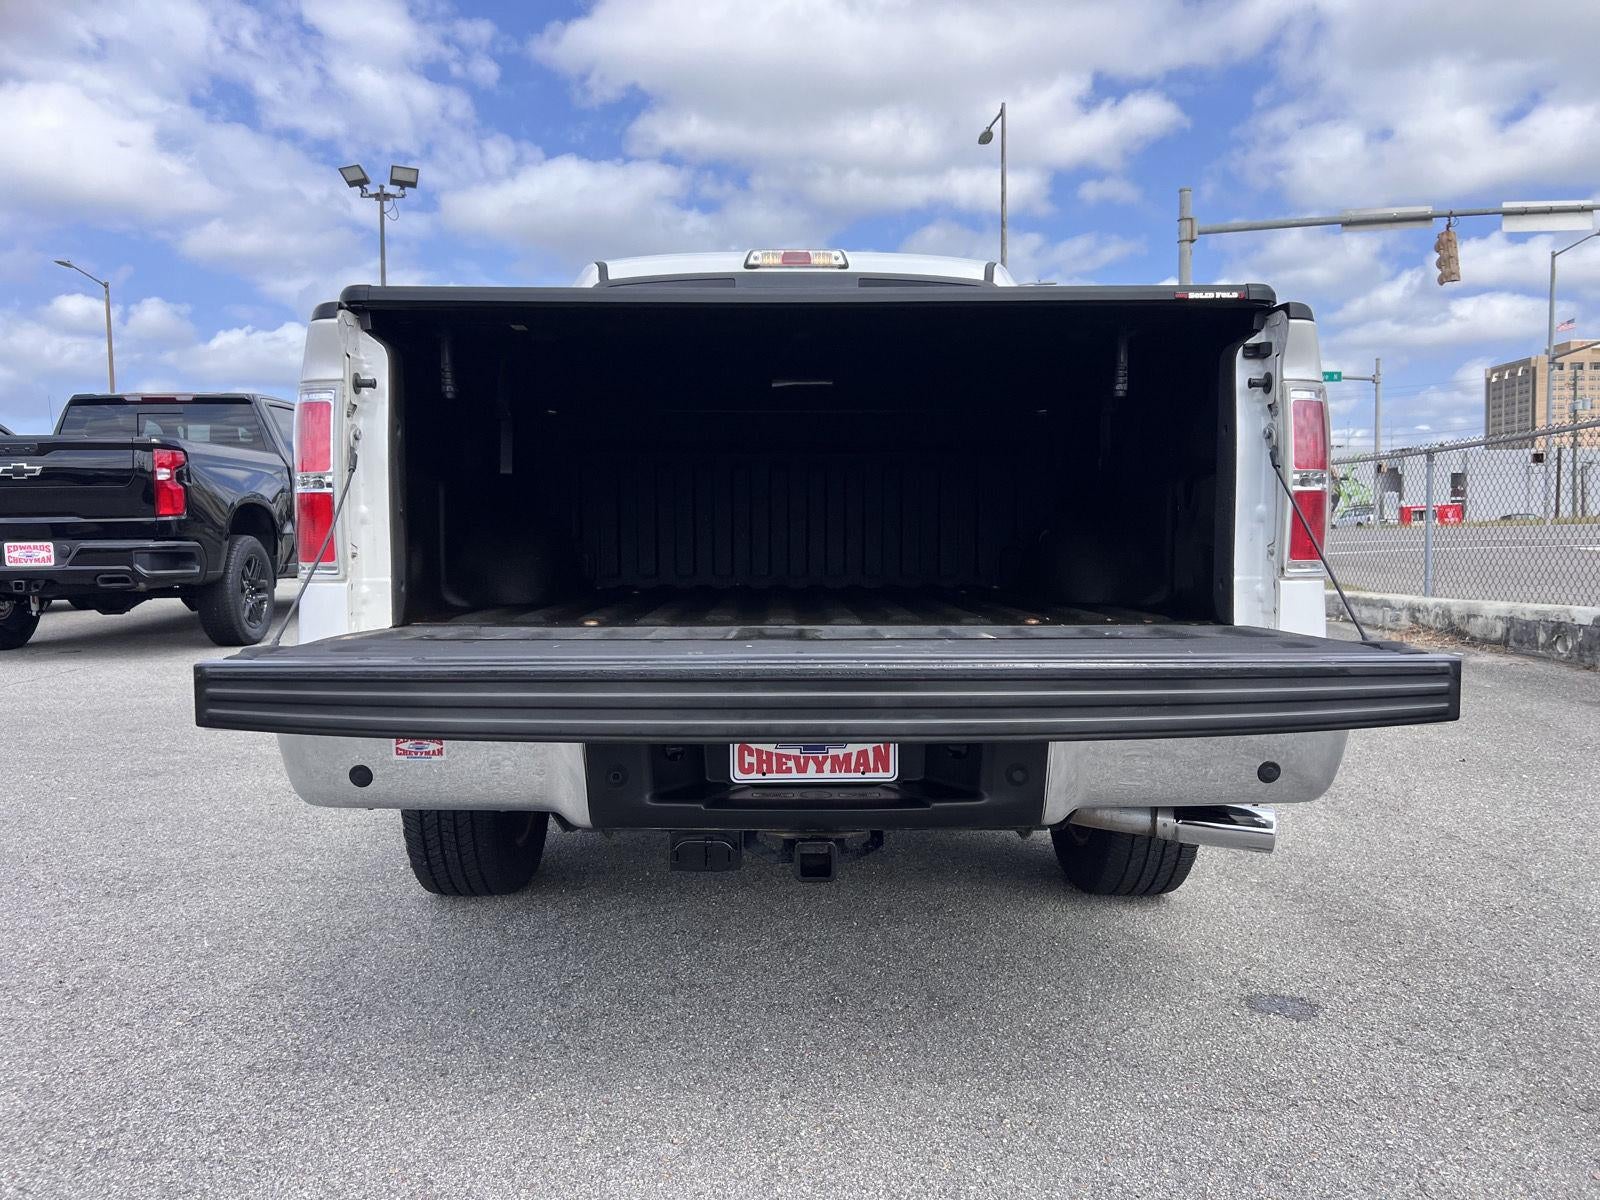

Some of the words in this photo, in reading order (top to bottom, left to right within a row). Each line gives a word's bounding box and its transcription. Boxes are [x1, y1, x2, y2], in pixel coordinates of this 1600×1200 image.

[1215, 291, 1239, 299] FOLD
[6, 544, 52, 554] EDWARDS
[7, 555, 52, 564] CHEVYMAN
[395, 747, 444, 756] CHEVYMAN
[737, 742, 891, 776] CHEVYMAN
